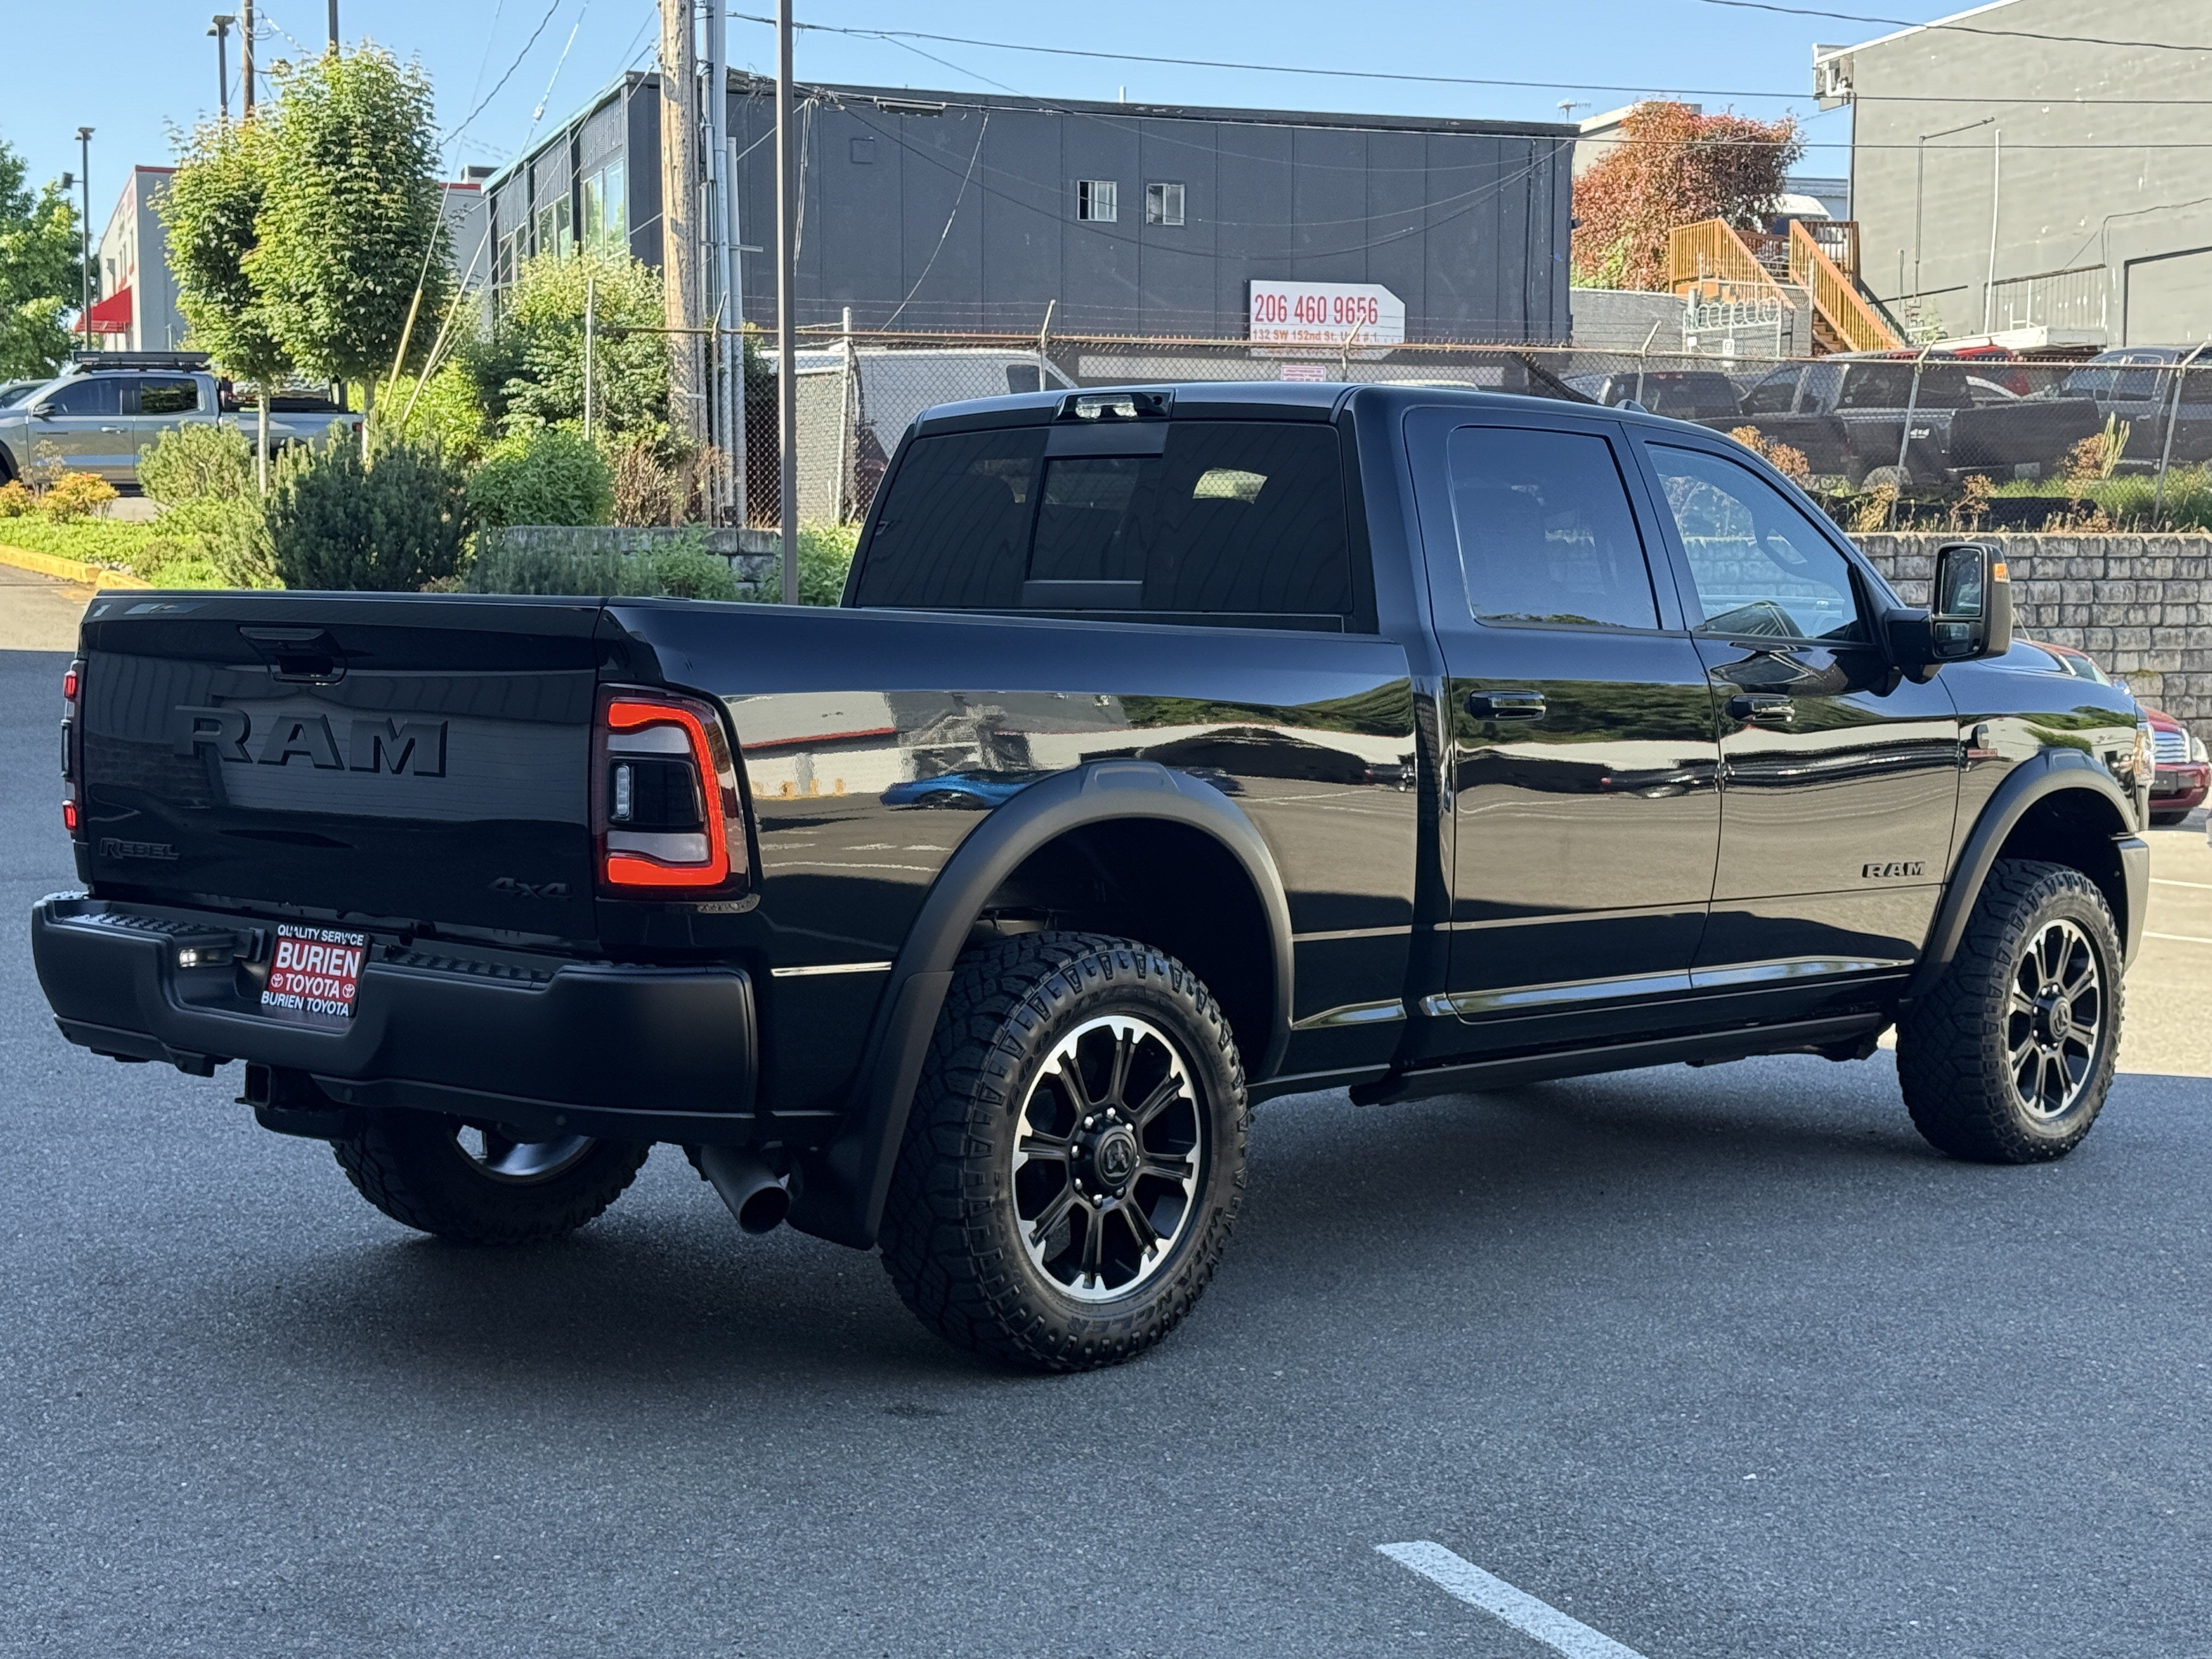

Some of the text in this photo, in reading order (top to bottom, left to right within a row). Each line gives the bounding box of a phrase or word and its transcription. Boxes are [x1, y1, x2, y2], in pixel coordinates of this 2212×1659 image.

[1254, 294, 1378, 325] 206 460 9656
[1253, 329, 1271, 340] 132
[1273, 329, 1289, 340] SW
[1292, 330, 1322, 341] 152nd
[174, 704, 449, 777] RAM
[1861, 861, 1926, 879] RAM
[278, 924, 364, 946] QUALITY SERVICE
[276, 941, 361, 978] BURIEN
[285, 973, 340, 998] TOYOTA
[261, 990, 349, 1016] BURIEN TOYOTA
